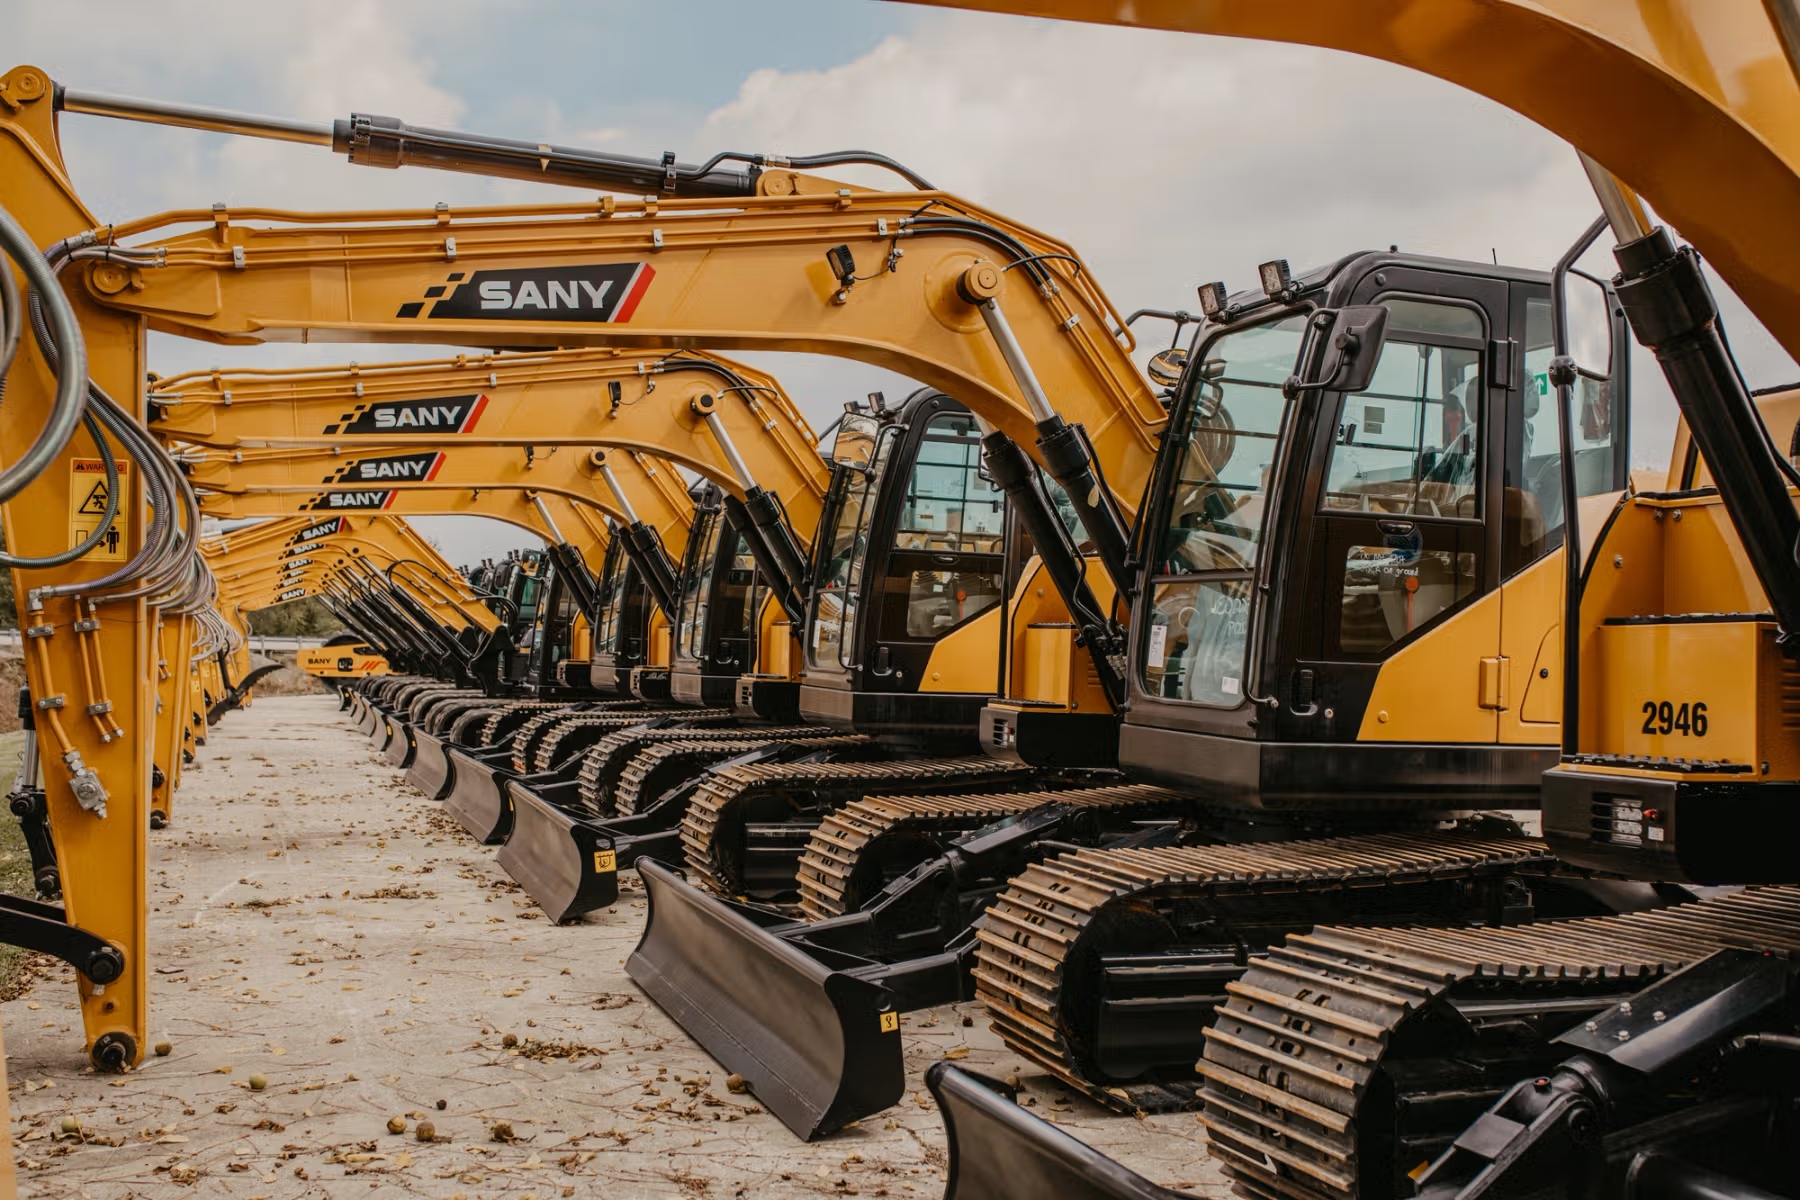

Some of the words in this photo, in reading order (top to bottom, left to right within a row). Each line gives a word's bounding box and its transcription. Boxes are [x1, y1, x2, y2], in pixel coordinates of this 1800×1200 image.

[479, 280, 614, 309] SANY
[374, 406, 462, 428] SANY
[86, 463, 124, 472] WARG
[360, 461, 426, 478] SANY
[329, 492, 384, 506] SANY
[302, 521, 337, 540] SANY
[281, 588, 305, 600] SANY
[1641, 701, 1708, 737] 2946
